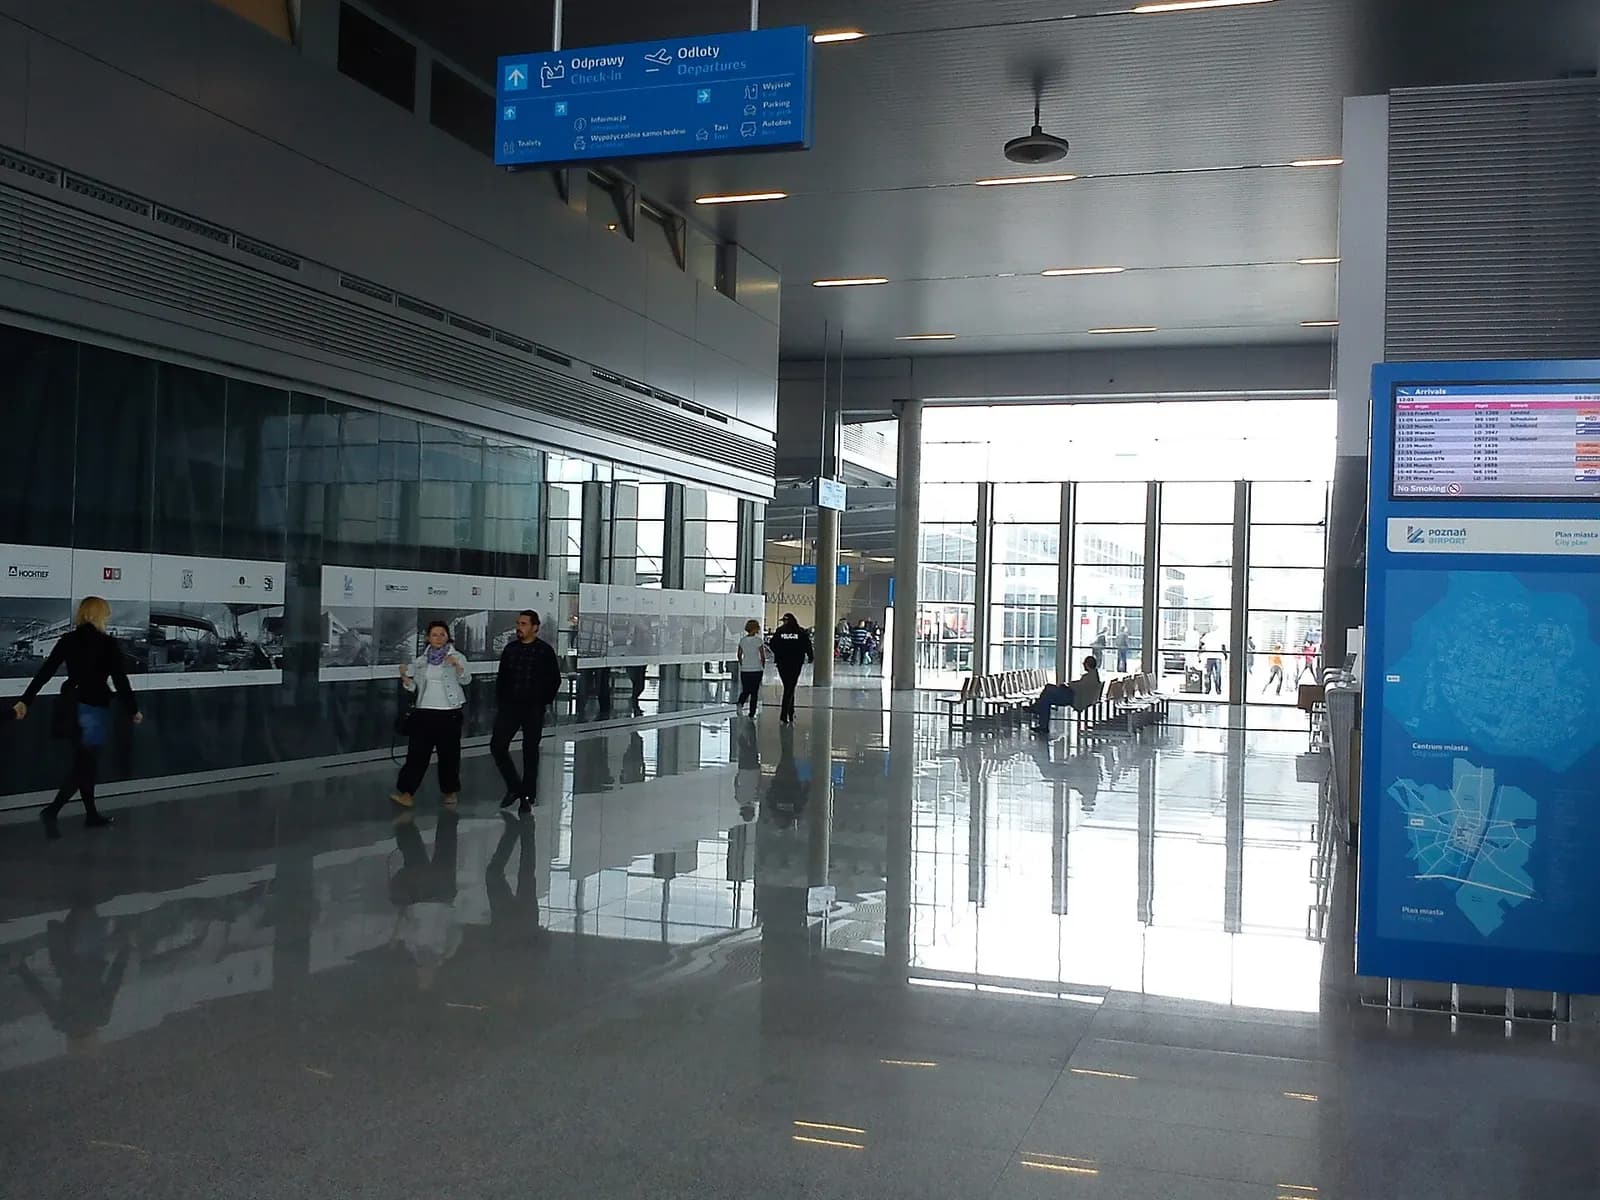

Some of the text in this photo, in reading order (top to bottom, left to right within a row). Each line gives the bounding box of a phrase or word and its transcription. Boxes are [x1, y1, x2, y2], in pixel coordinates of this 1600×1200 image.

[678, 46, 720, 60] Odloty
[571, 56, 625, 72] Odprawy
[678, 61, 747, 78] Departures
[571, 70, 623, 85] Check-in
[763, 100, 791, 109] Parking
[714, 123, 729, 132] Taxi
[762, 119, 792, 128] Autobus
[1415, 388, 1447, 396] Arrivals
[1410, 484, 1447, 493] Smoking
[1554, 539, 1570, 547] City
[19, 569, 49, 579] HOCHTIEF
[1412, 742, 1469, 752] Centrum miasta
[1419, 908, 1445, 916] miasta
